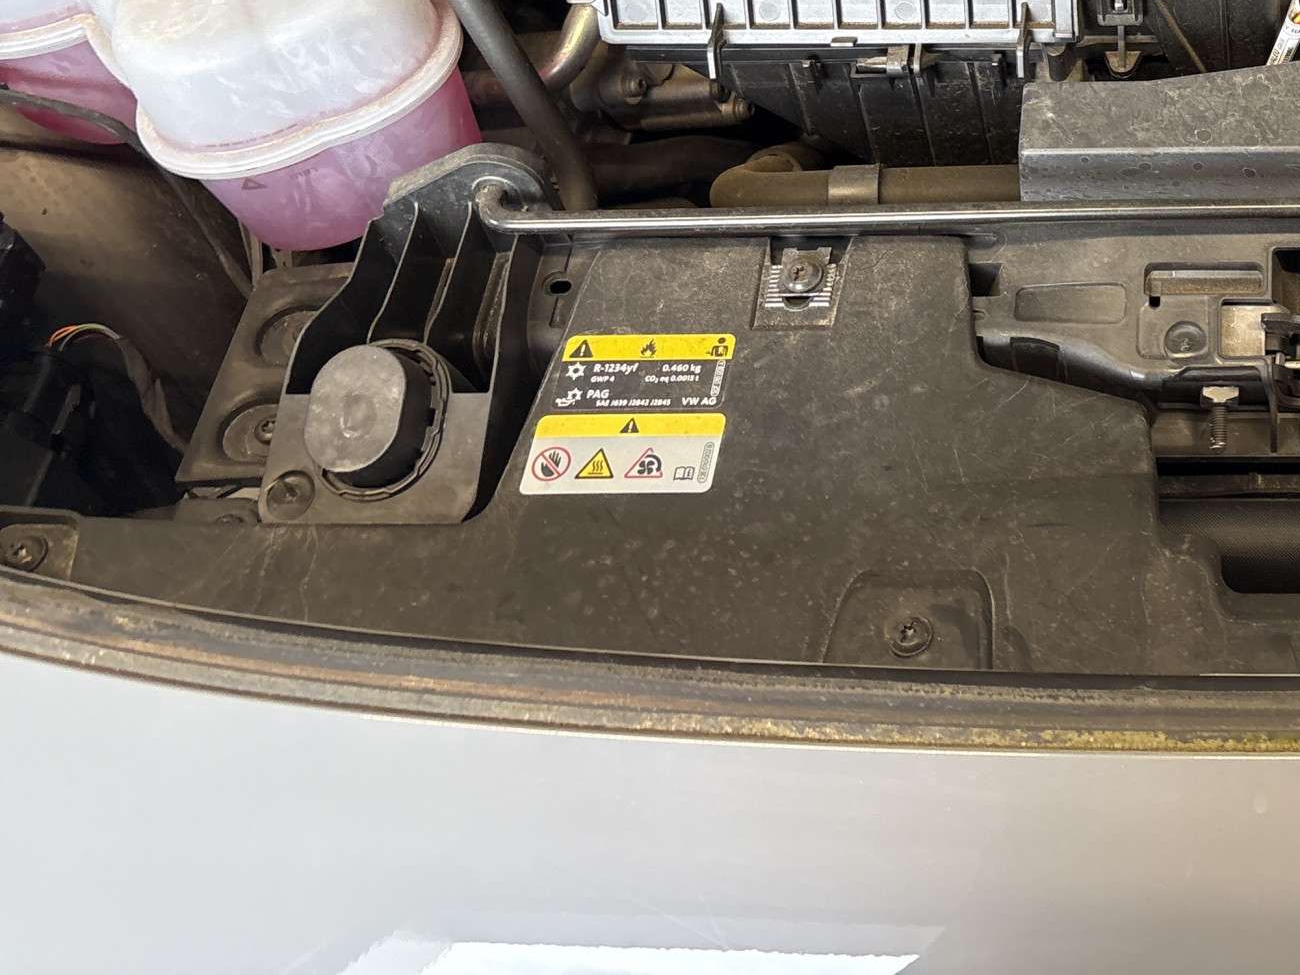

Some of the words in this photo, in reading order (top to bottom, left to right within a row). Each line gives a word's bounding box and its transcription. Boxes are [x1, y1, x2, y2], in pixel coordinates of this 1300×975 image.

[593, 363, 639, 375] R-1234yf
[662, 364, 689, 372] 0.460
[690, 364, 701, 374] kg
[586, 389, 610, 399] PAG
[682, 397, 700, 406] VW
[701, 397, 717, 406] AG
